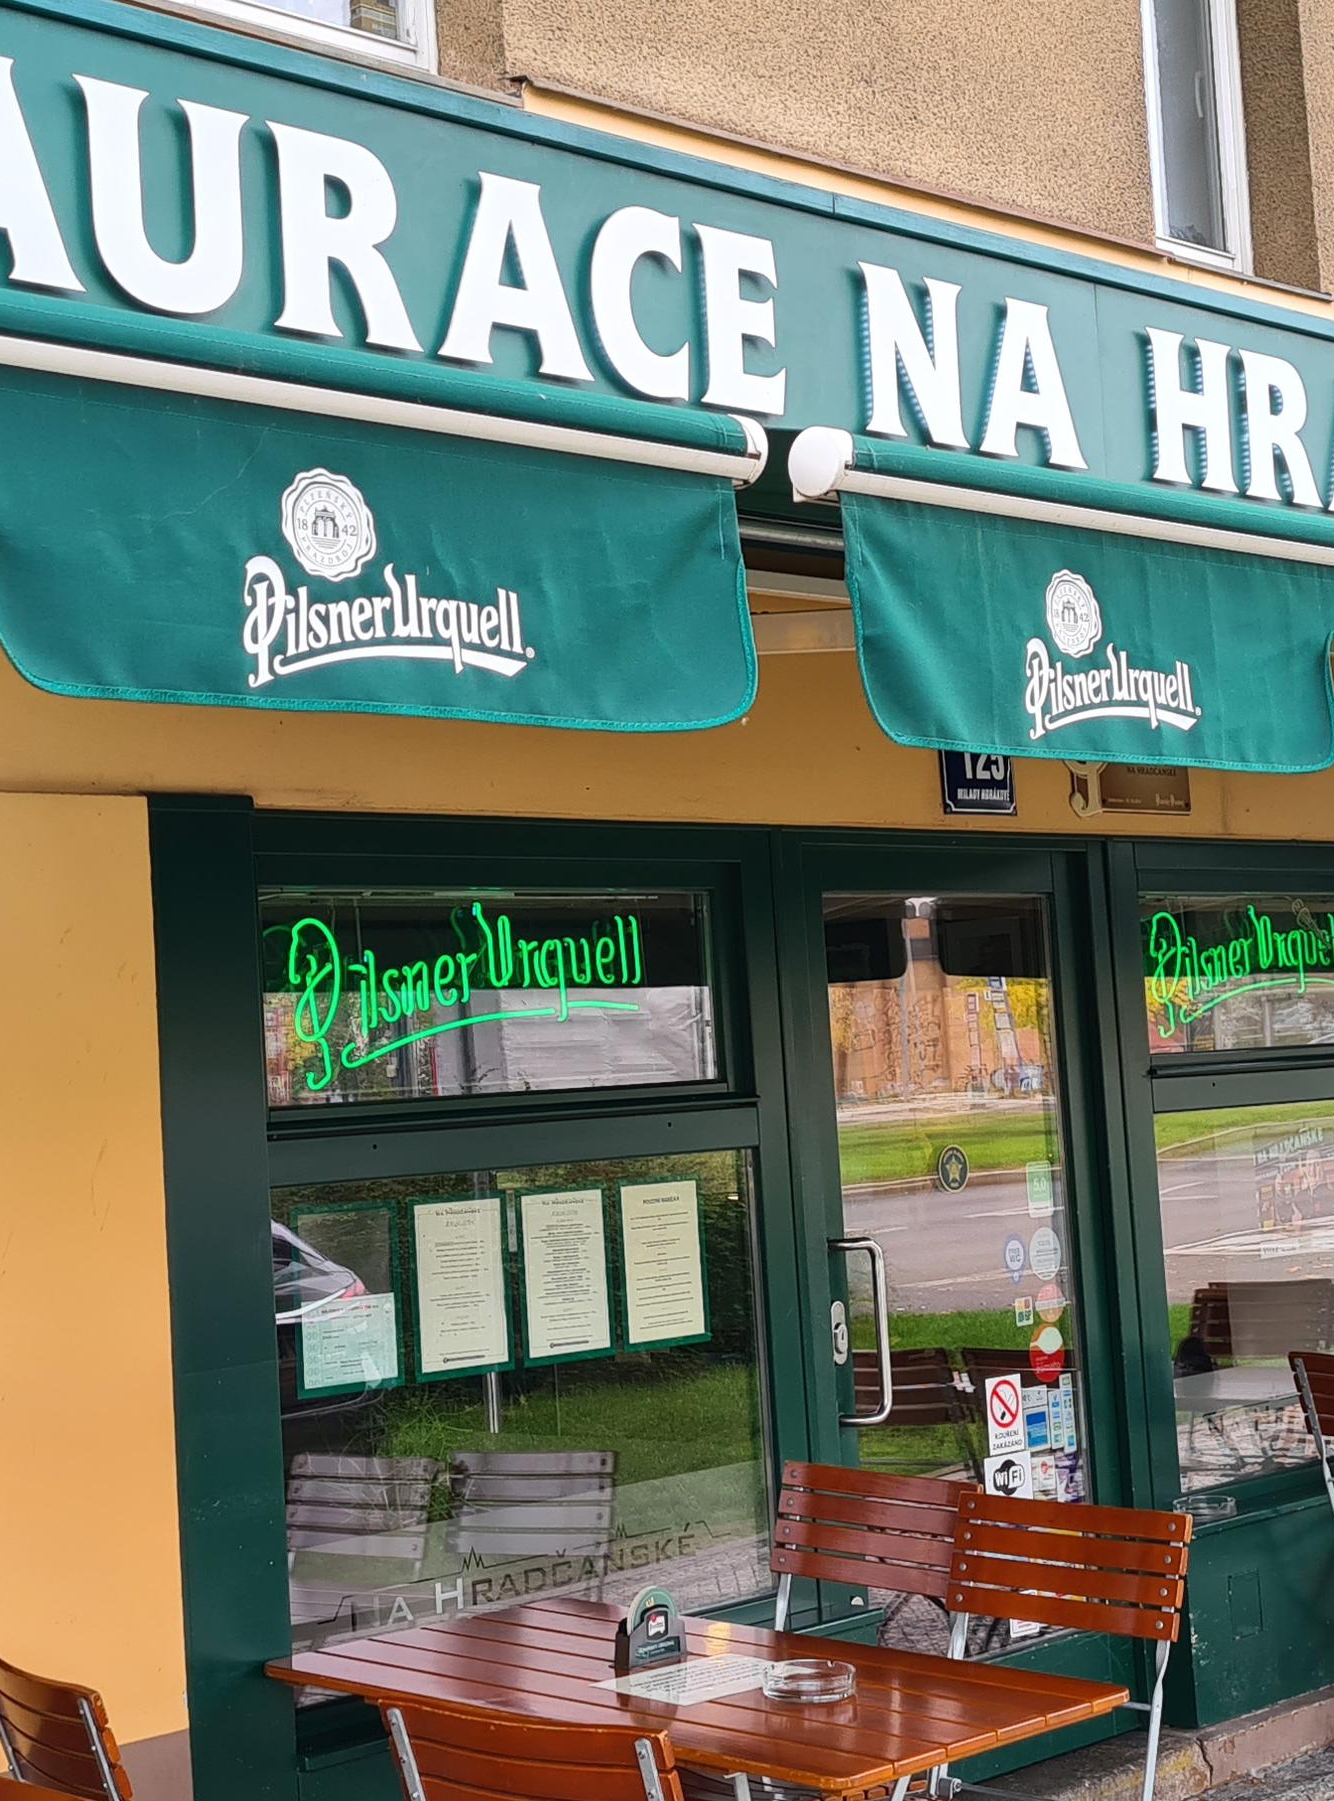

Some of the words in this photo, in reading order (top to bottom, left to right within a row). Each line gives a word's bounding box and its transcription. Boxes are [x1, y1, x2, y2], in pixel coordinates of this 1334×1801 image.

[857, 262, 1087, 471] NA
[243, 555, 391, 688] Pilsner
[384, 563, 524, 673] Urquell
[1025, 637, 1111, 740] Pilsner
[1106, 642, 1195, 730] Urquell
[964, 753, 1005, 780] 125
[288, 917, 477, 1091] Pilsner
[471, 901, 642, 1022] Urquell
[1150, 911, 1252, 1039] Pilsner
[434, 1521, 697, 1615] HRADČANSKÉ
